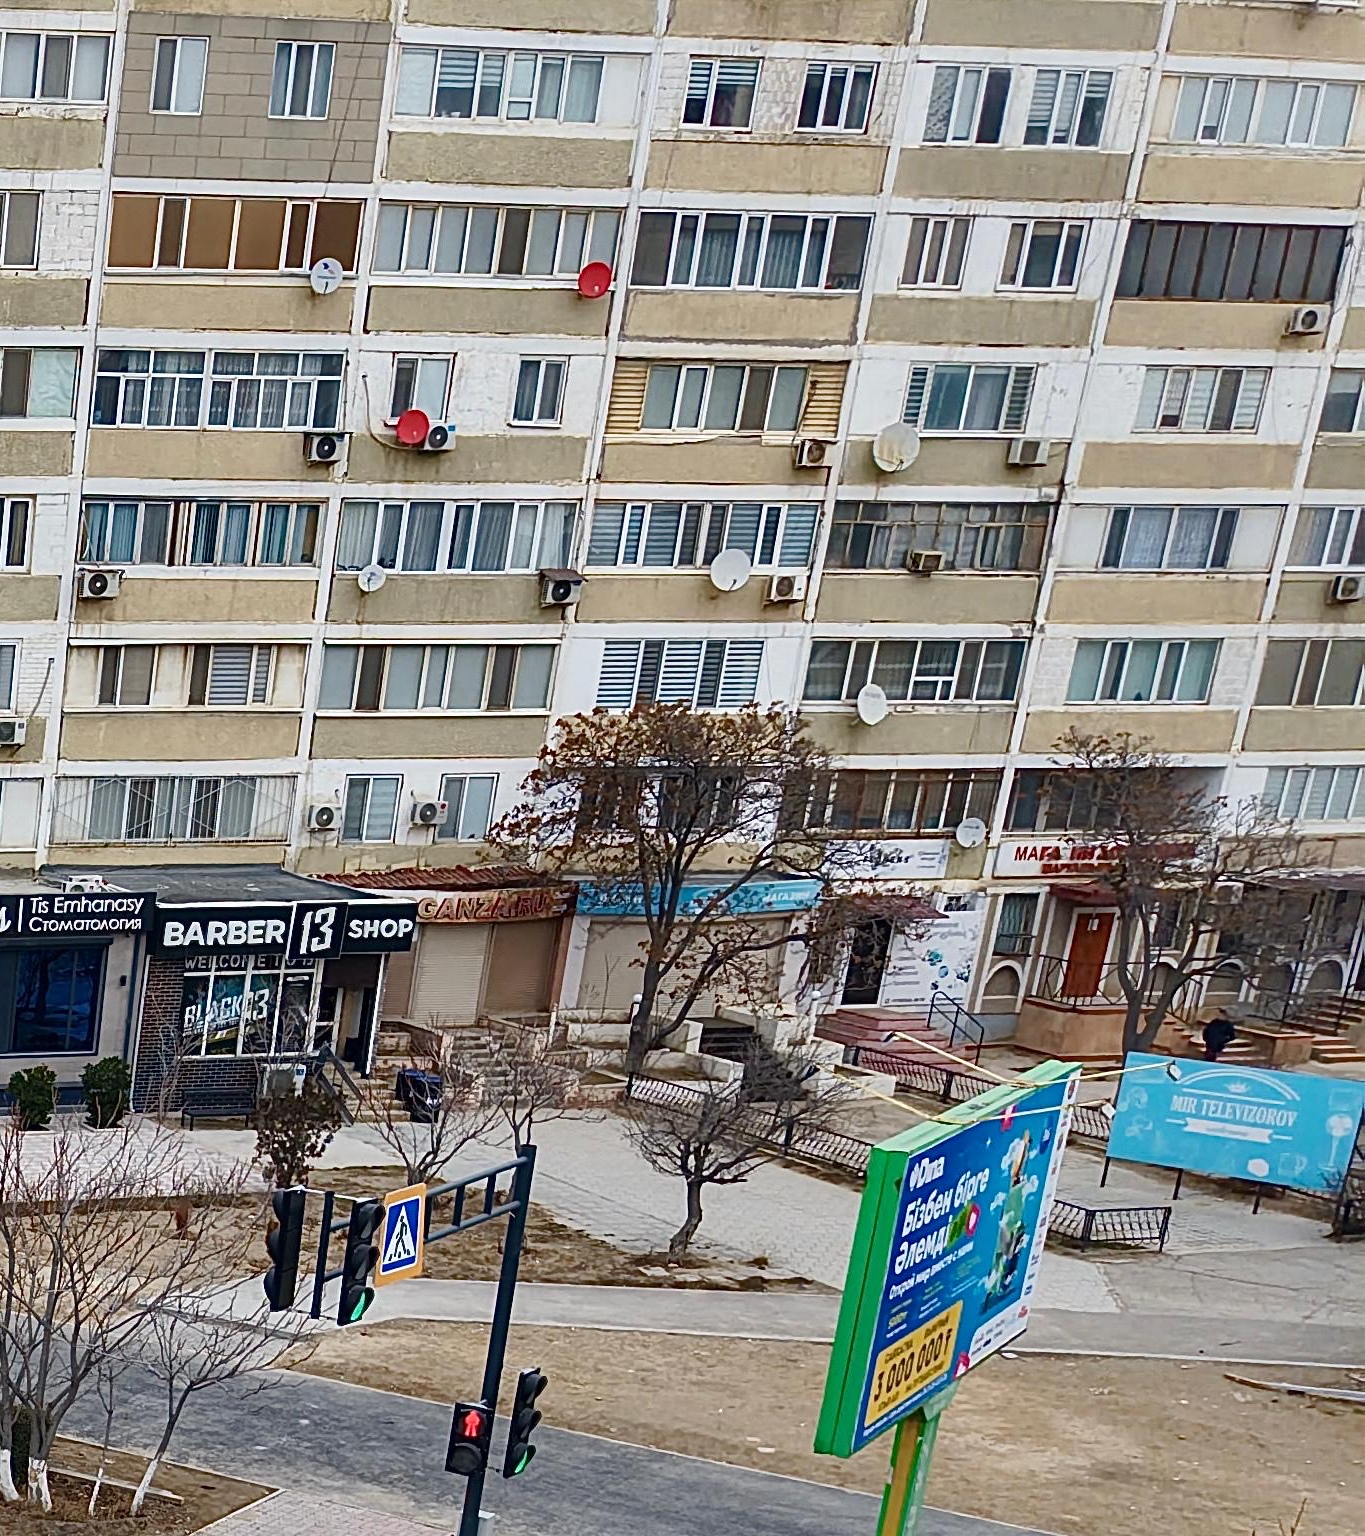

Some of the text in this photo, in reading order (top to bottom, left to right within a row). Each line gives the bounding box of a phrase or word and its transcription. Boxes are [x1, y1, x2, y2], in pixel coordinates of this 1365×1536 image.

[29, 918, 143, 932] Стоматология
[30, 897, 144, 920] Tis Emhanasy
[163, 907, 414, 955] BARBER 13 SHOP
[1171, 1095, 1298, 1127] MIR TELEVIZOROV
[901, 1188, 954, 1238] Бізбен
[874, 1371, 885, 1402] 3
[886, 1351, 915, 1394] 000
